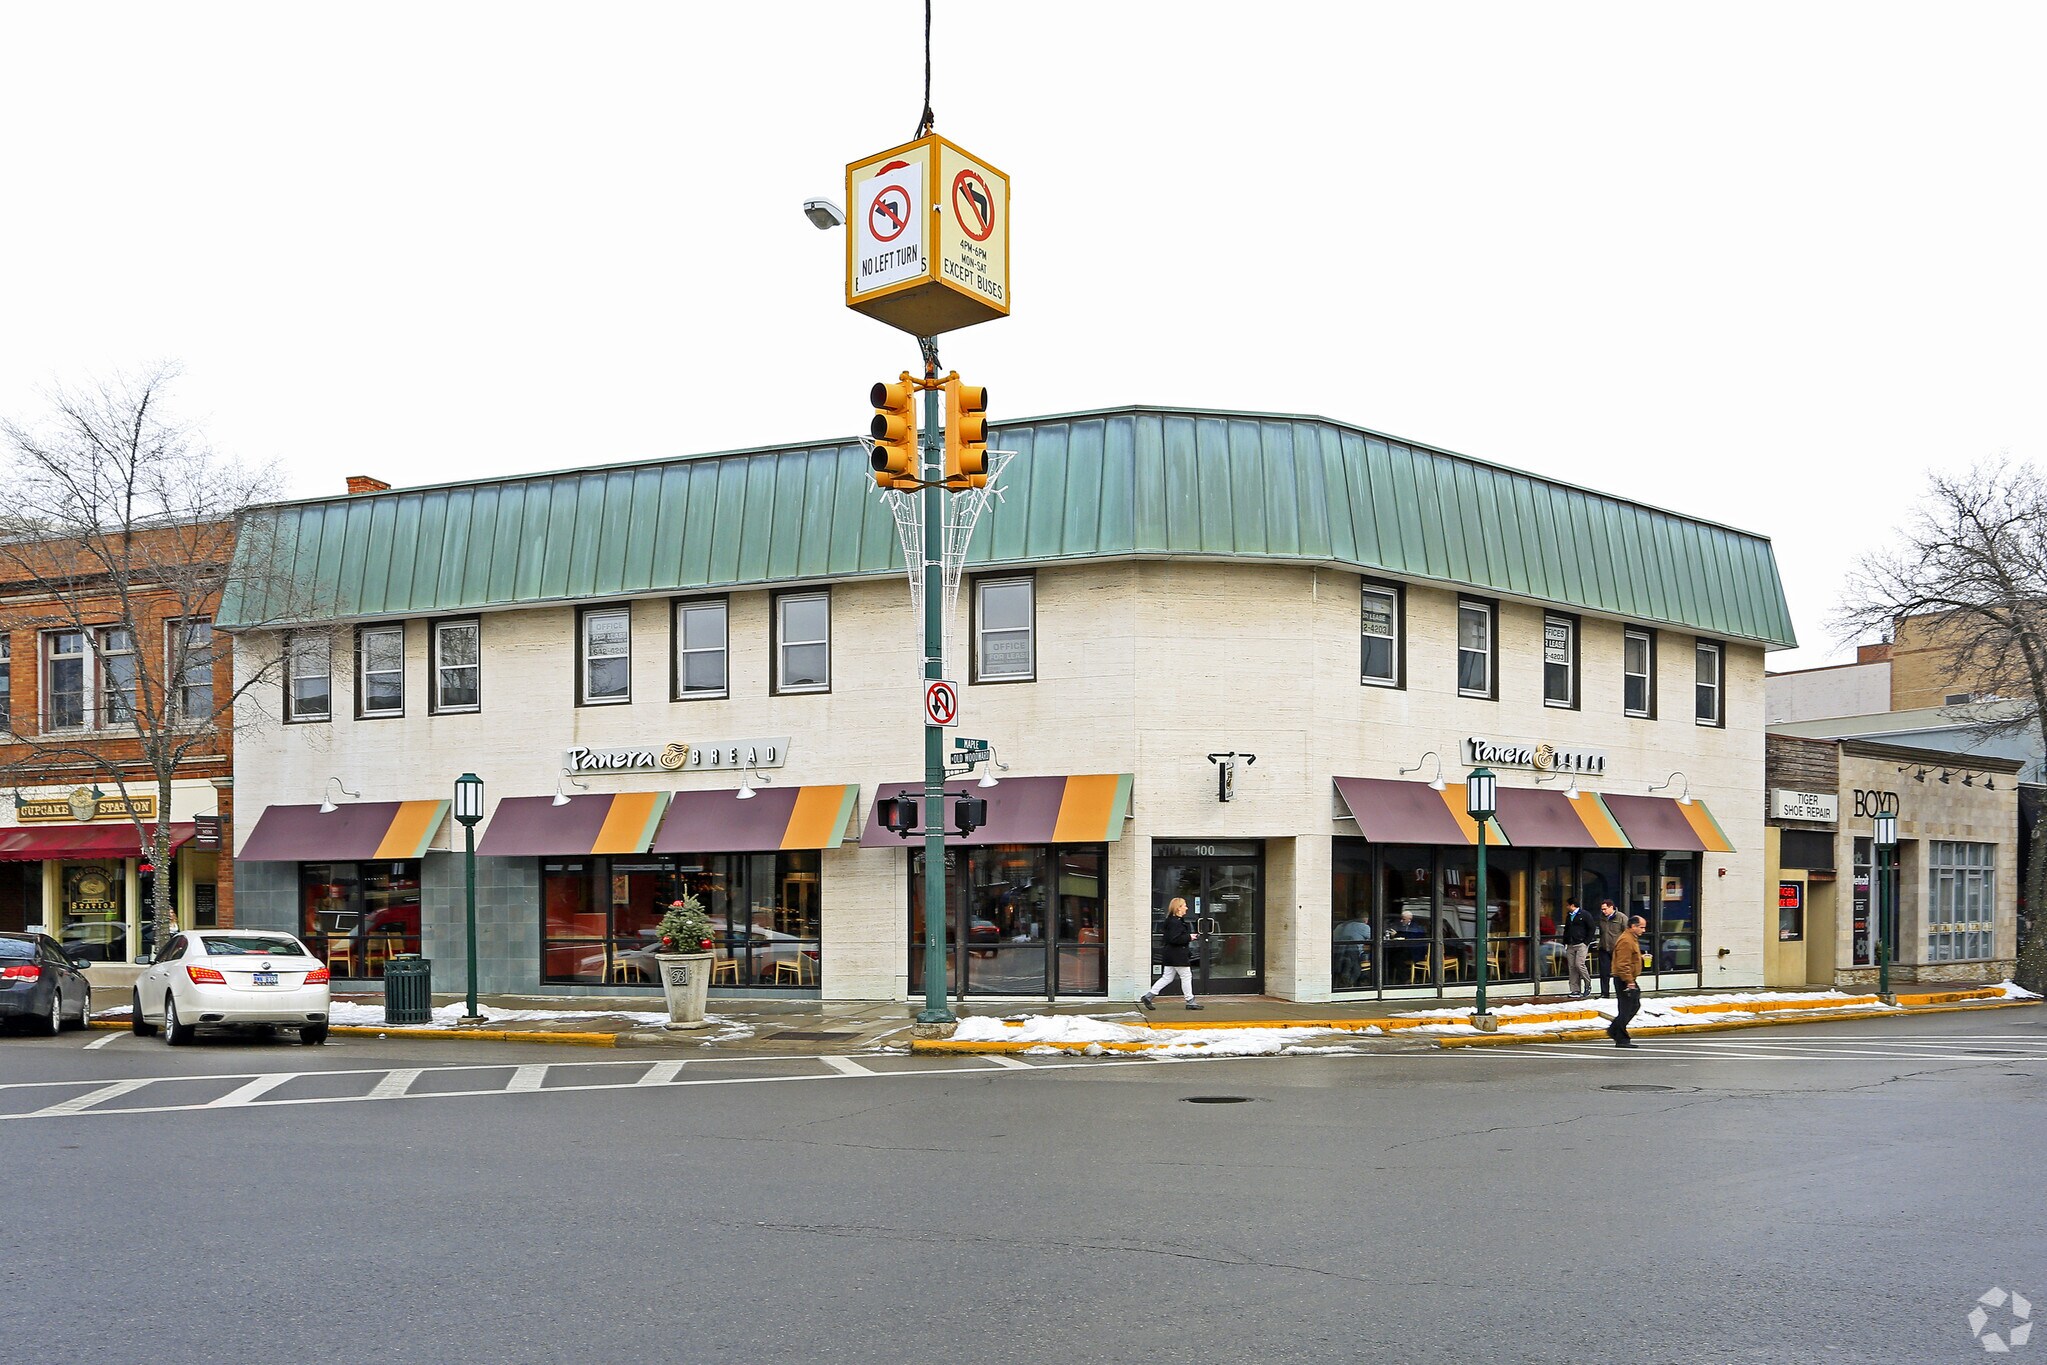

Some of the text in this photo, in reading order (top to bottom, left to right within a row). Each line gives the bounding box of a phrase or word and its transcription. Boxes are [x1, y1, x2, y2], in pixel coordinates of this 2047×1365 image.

[960, 239, 987, 261] 4PM-6PM
[862, 257, 873, 277] NO
[875, 251, 895, 274] LEFT
[896, 244, 918, 267] TURN
[961, 253, 987, 274] MON-SAT
[944, 258, 974, 286] EXCEPT
[977, 274, 1003, 300] BUSES
[596, 622, 624, 631] OFFICE
[1363, 623, 1387, 634] 2-4203
[608, 632, 628, 640] LEAS
[993, 641, 1026, 651] OFFICE
[1549, 640, 1566, 649] LEASE
[1007, 651, 1028, 660] LEAS
[963, 739, 980, 750] MAPLE
[567, 746, 776, 771] Panera BREAD
[964, 750, 989, 762] WOODWARD
[1469, 737, 1607, 771] Panera BREAD
[1798, 793, 1819, 805] TIGER
[1853, 789, 1900, 818] BOYD
[20, 804, 69, 817] CUPCAKE
[1783, 804, 1831, 819] SHOE REPAIR
[1195, 845, 1215, 856] 100
[72, 901, 116, 910] STATION
